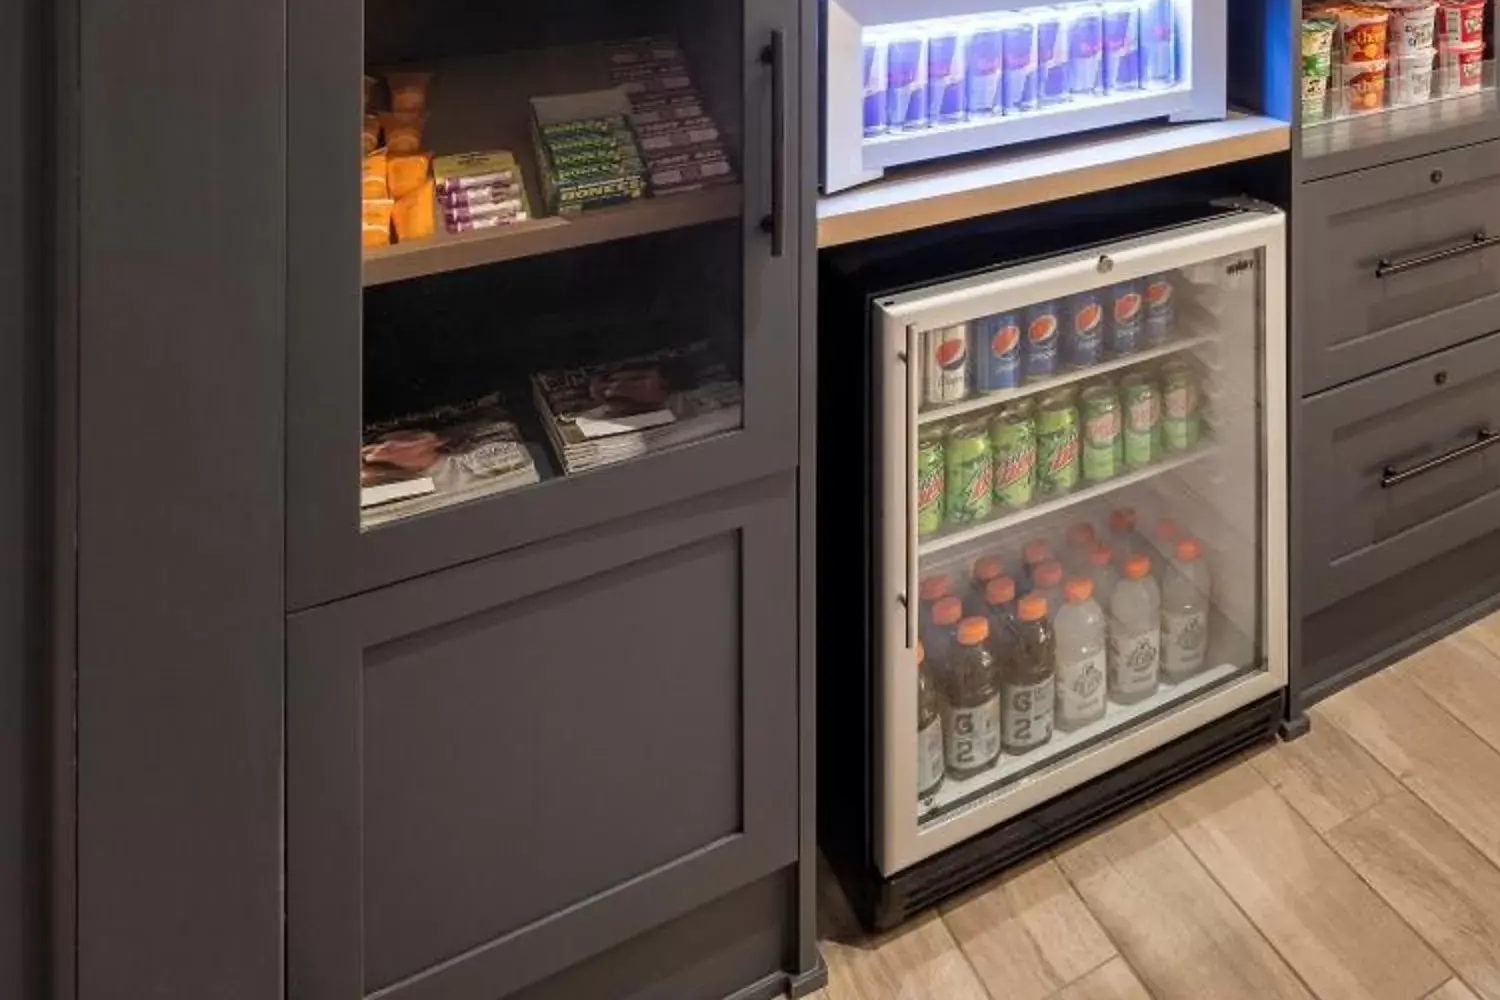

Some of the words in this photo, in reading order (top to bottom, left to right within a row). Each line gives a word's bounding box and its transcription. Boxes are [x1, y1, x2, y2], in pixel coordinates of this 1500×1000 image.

[1013, 690, 1032, 713] G
[955, 713, 974, 733] G
[1014, 717, 1032, 741] 2
[956, 741, 974, 763] 2
